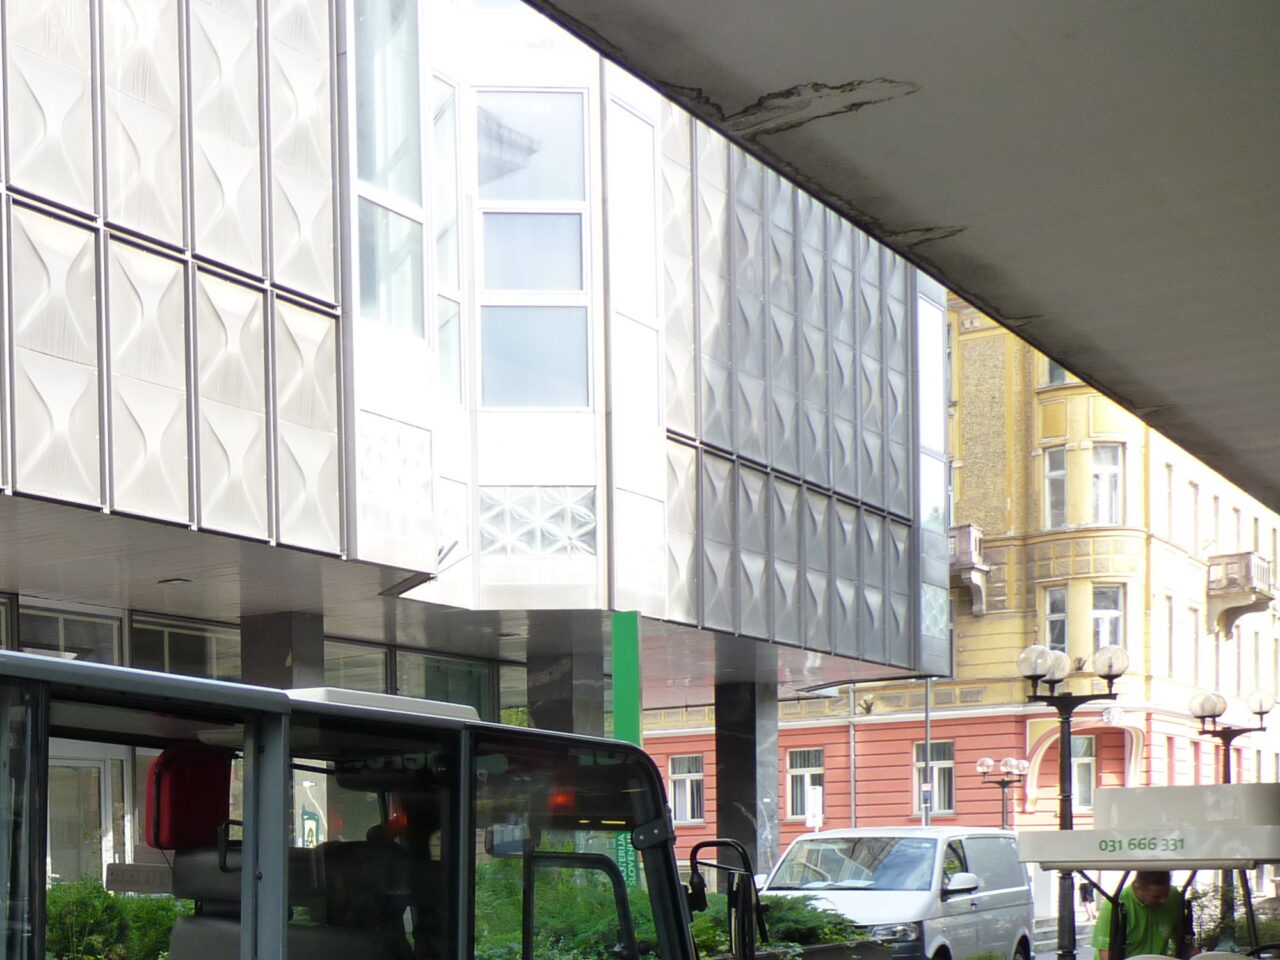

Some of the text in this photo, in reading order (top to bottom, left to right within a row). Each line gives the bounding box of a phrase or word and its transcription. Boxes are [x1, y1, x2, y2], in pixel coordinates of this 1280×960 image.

[1098, 837, 1185, 853] 031 666 331
